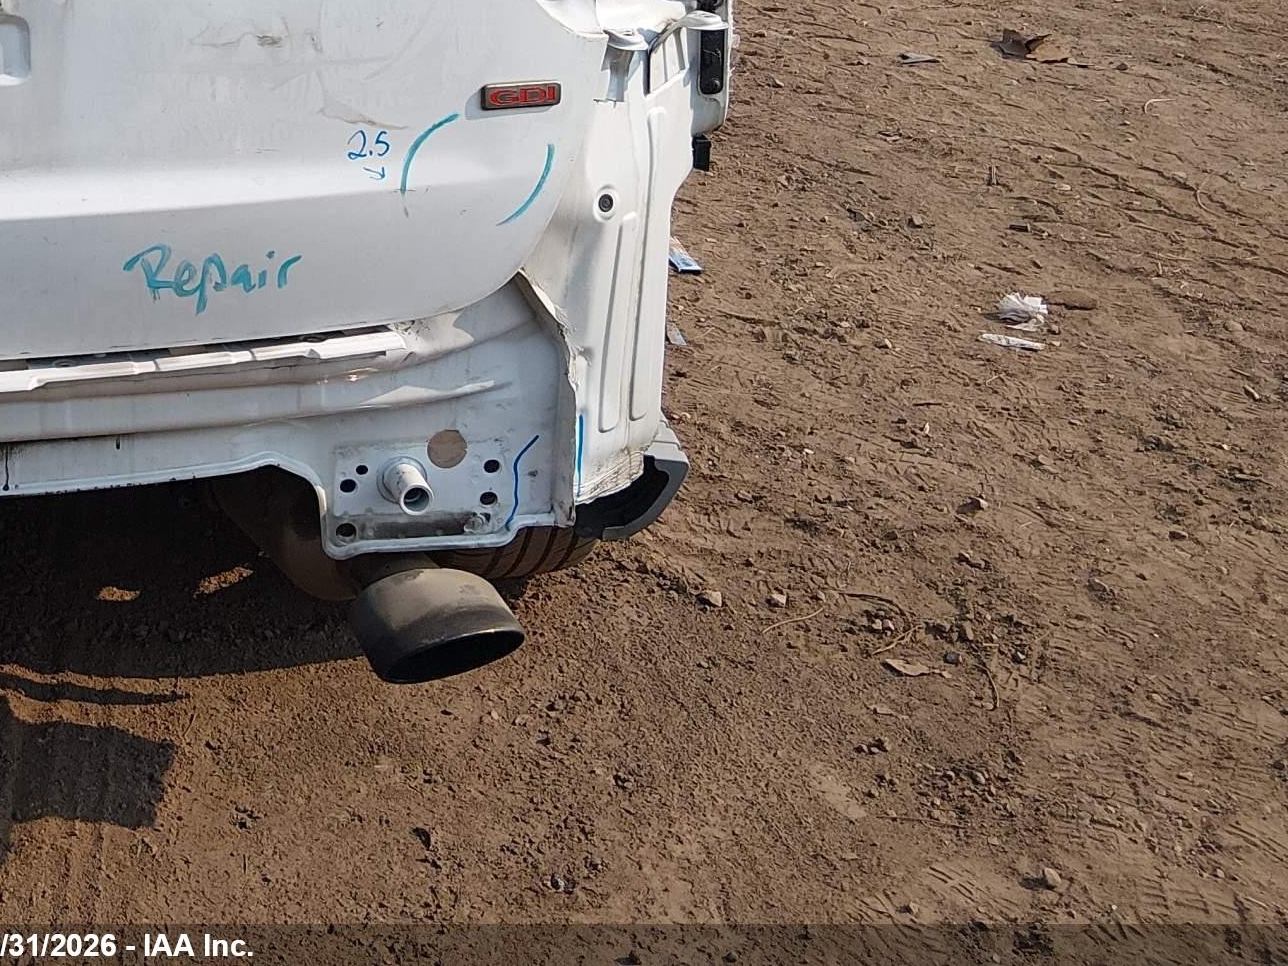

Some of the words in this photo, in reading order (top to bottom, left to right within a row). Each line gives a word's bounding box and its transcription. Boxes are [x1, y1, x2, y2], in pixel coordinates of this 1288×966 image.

[489, 85, 556, 106] GDI
[347, 129, 390, 160] 2.5
[123, 244, 302, 314] Repair
